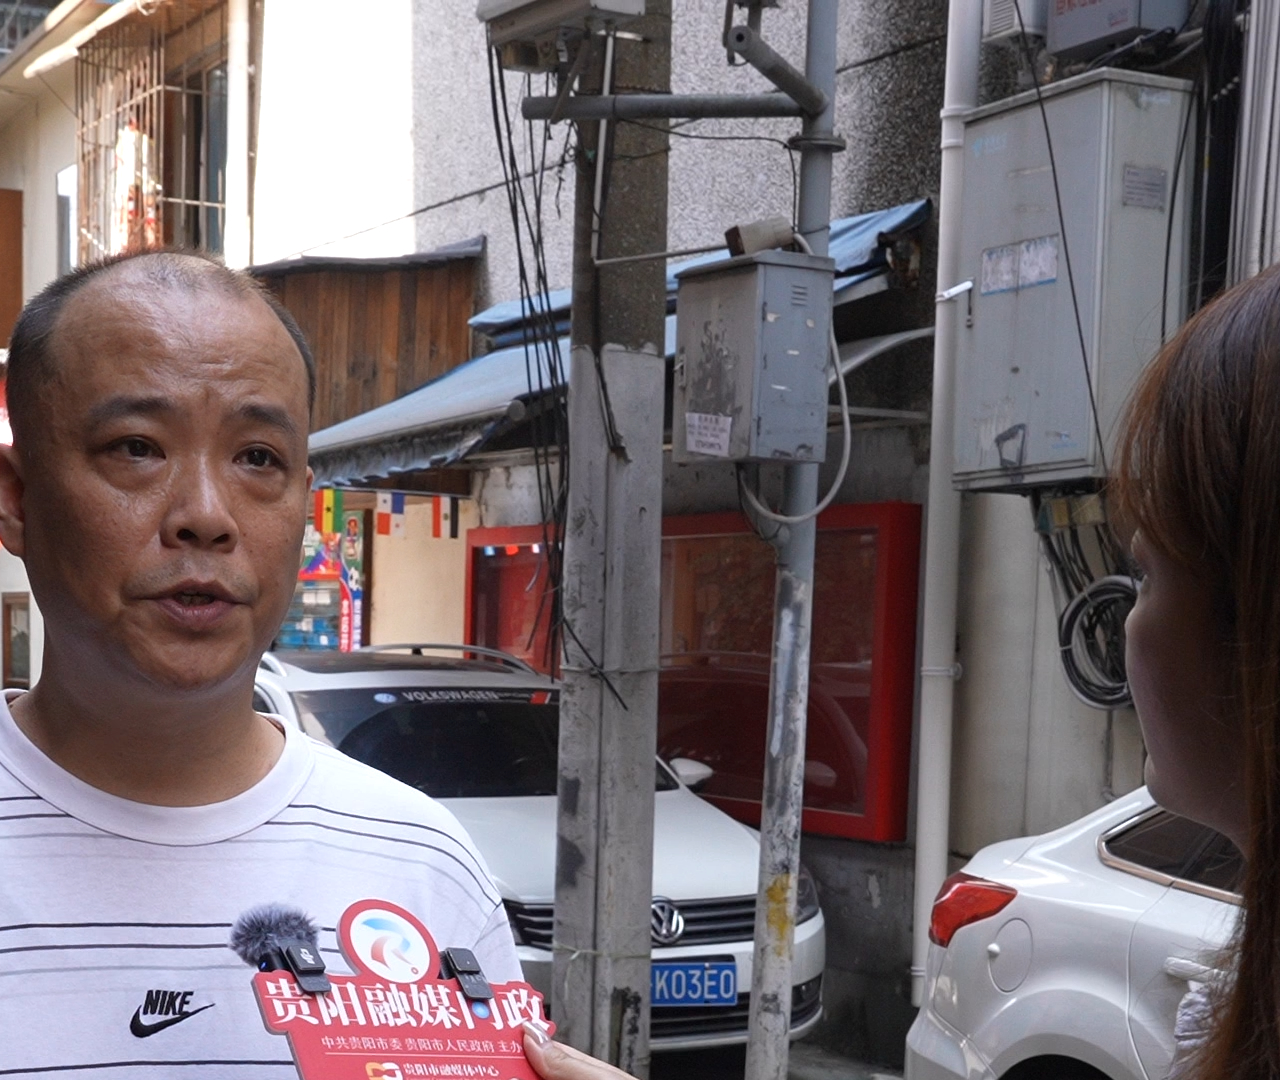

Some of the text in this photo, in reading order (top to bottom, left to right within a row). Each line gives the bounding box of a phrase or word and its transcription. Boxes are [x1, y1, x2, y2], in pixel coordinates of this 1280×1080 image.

[401, 690, 500, 701] VOLKSWAGEN
[142, 989, 195, 1016] NIKE
[321, 1035, 522, 1054] 中共贵阳市委 贵阳市人民政府 主办
[403, 1062, 500, 1077] 贵阳市融媒体中心
